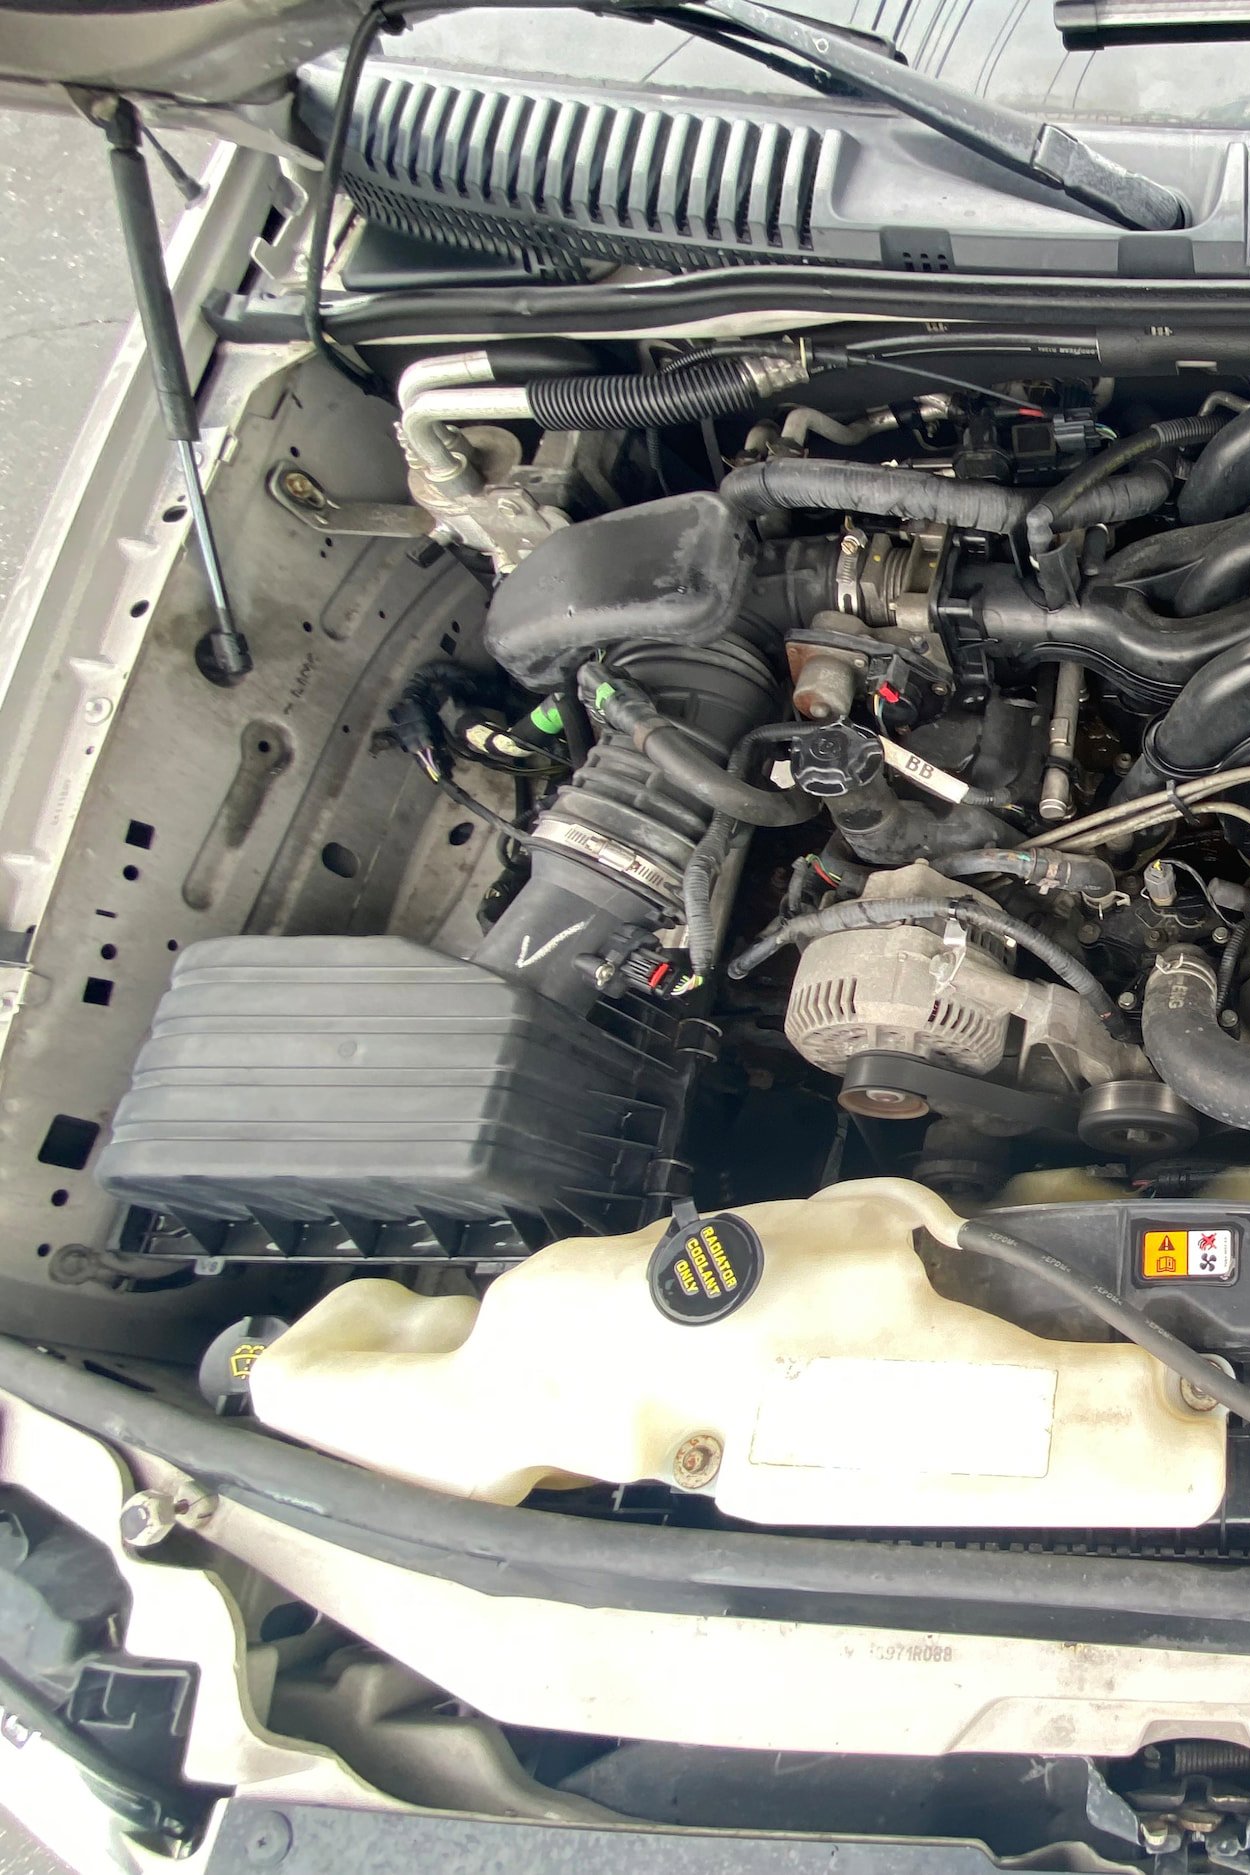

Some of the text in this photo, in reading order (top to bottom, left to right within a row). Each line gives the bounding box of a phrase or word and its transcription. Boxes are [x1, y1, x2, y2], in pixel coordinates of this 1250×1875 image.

[905, 755, 935, 780] BB
[676, 1259, 699, 1293] ONLY
[686, 1237, 721, 1295] COOLANT
[702, 1226, 738, 1289] RADIATOR
